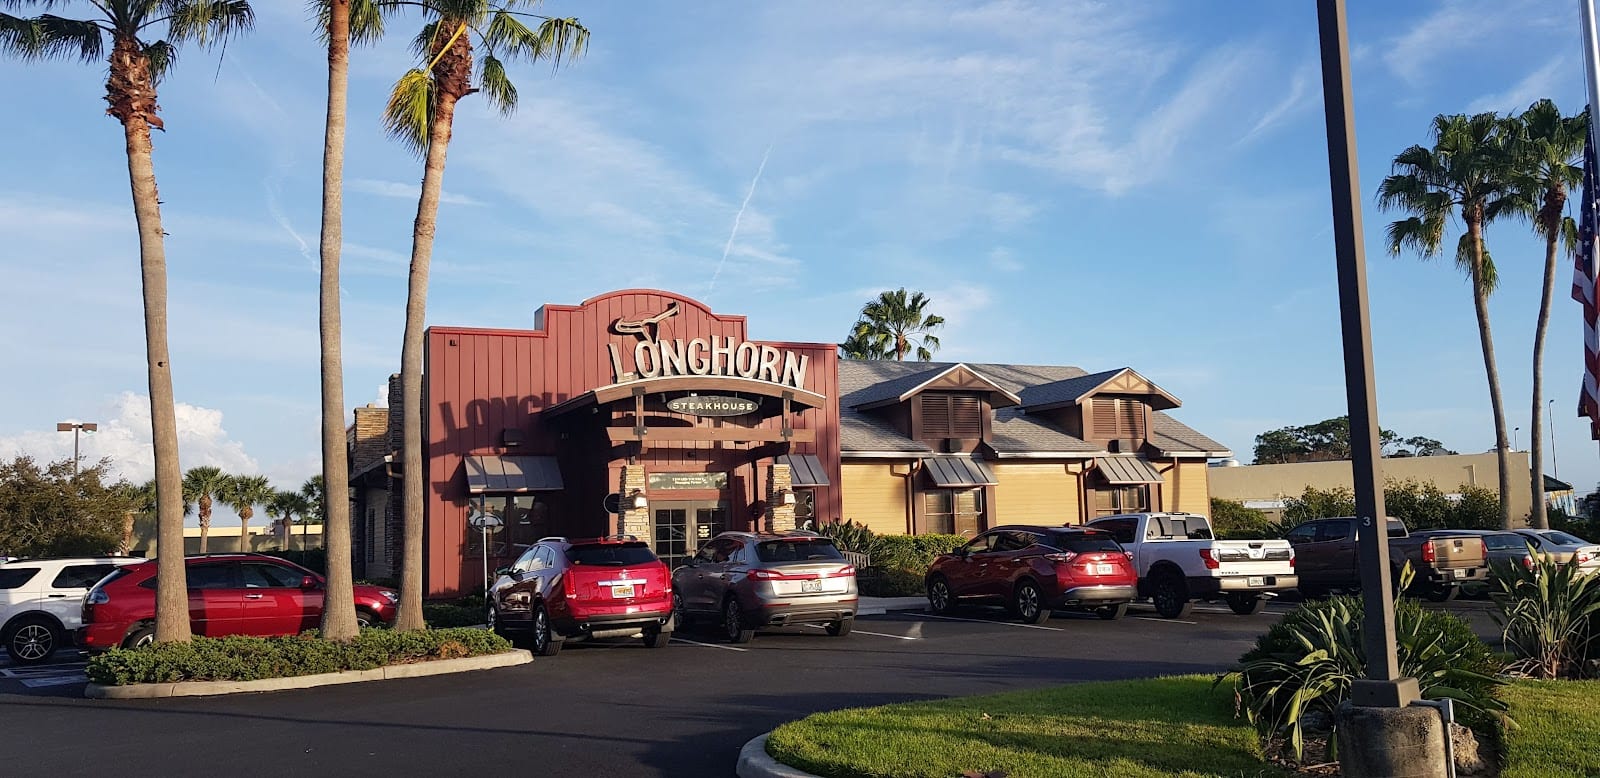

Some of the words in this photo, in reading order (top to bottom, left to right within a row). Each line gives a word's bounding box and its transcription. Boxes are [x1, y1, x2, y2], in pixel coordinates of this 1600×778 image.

[608, 335, 809, 389] LONGHORN
[672, 402, 753, 411] STEAKHOUSE
[1362, 516, 1371, 526] 3
